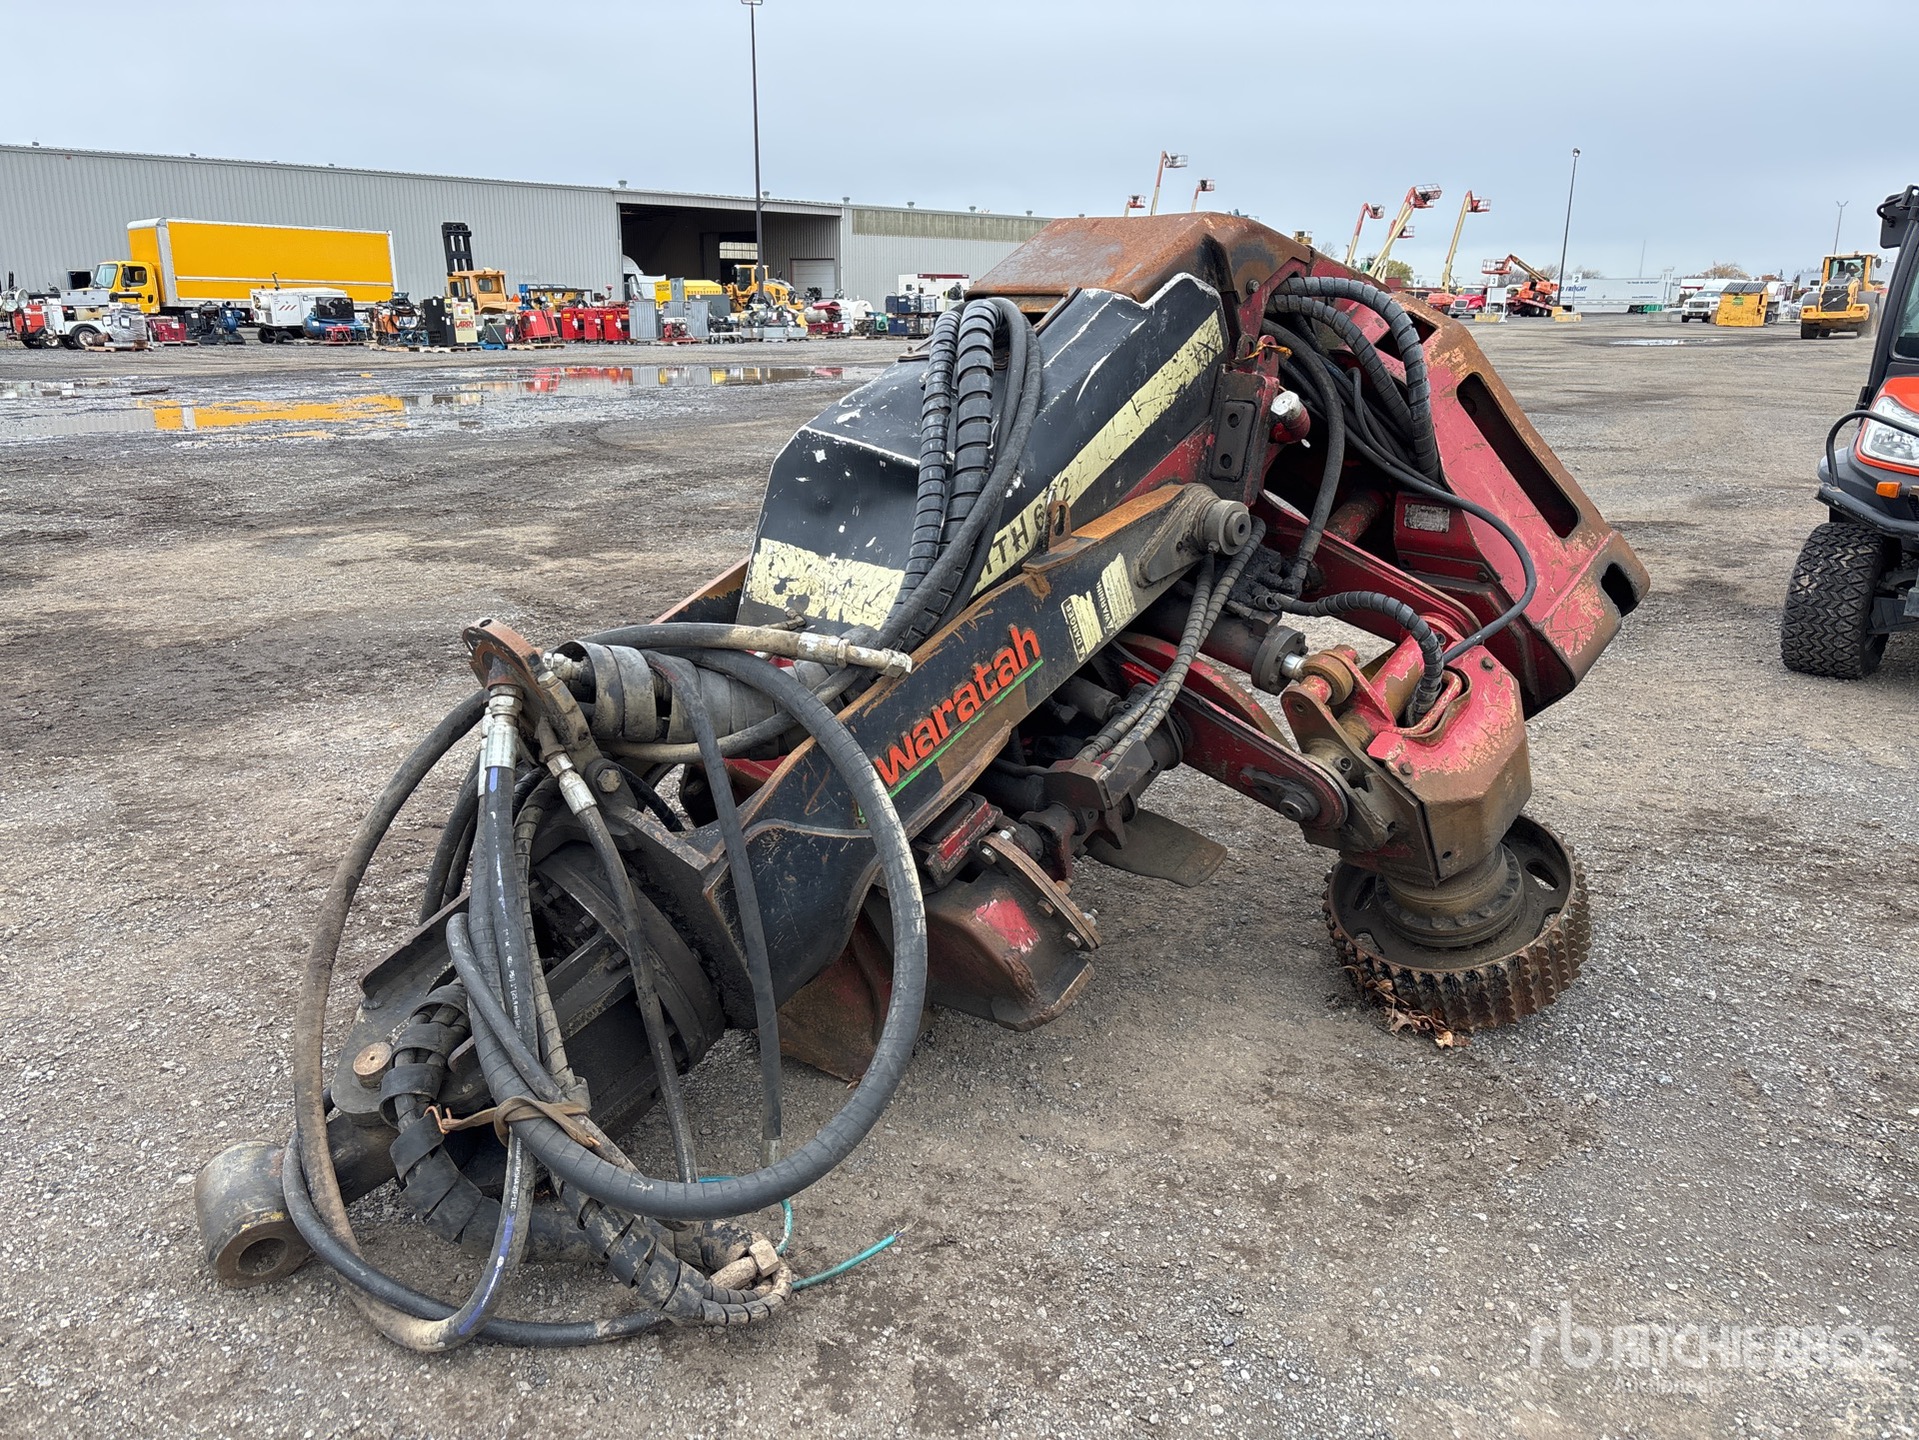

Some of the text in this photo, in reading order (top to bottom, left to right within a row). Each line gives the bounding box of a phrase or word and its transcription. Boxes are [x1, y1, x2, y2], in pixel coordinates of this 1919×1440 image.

[455, 320, 475, 329] LARRY
[1065, 603, 1082, 645] DANGER
[873, 624, 1041, 787] waratah
